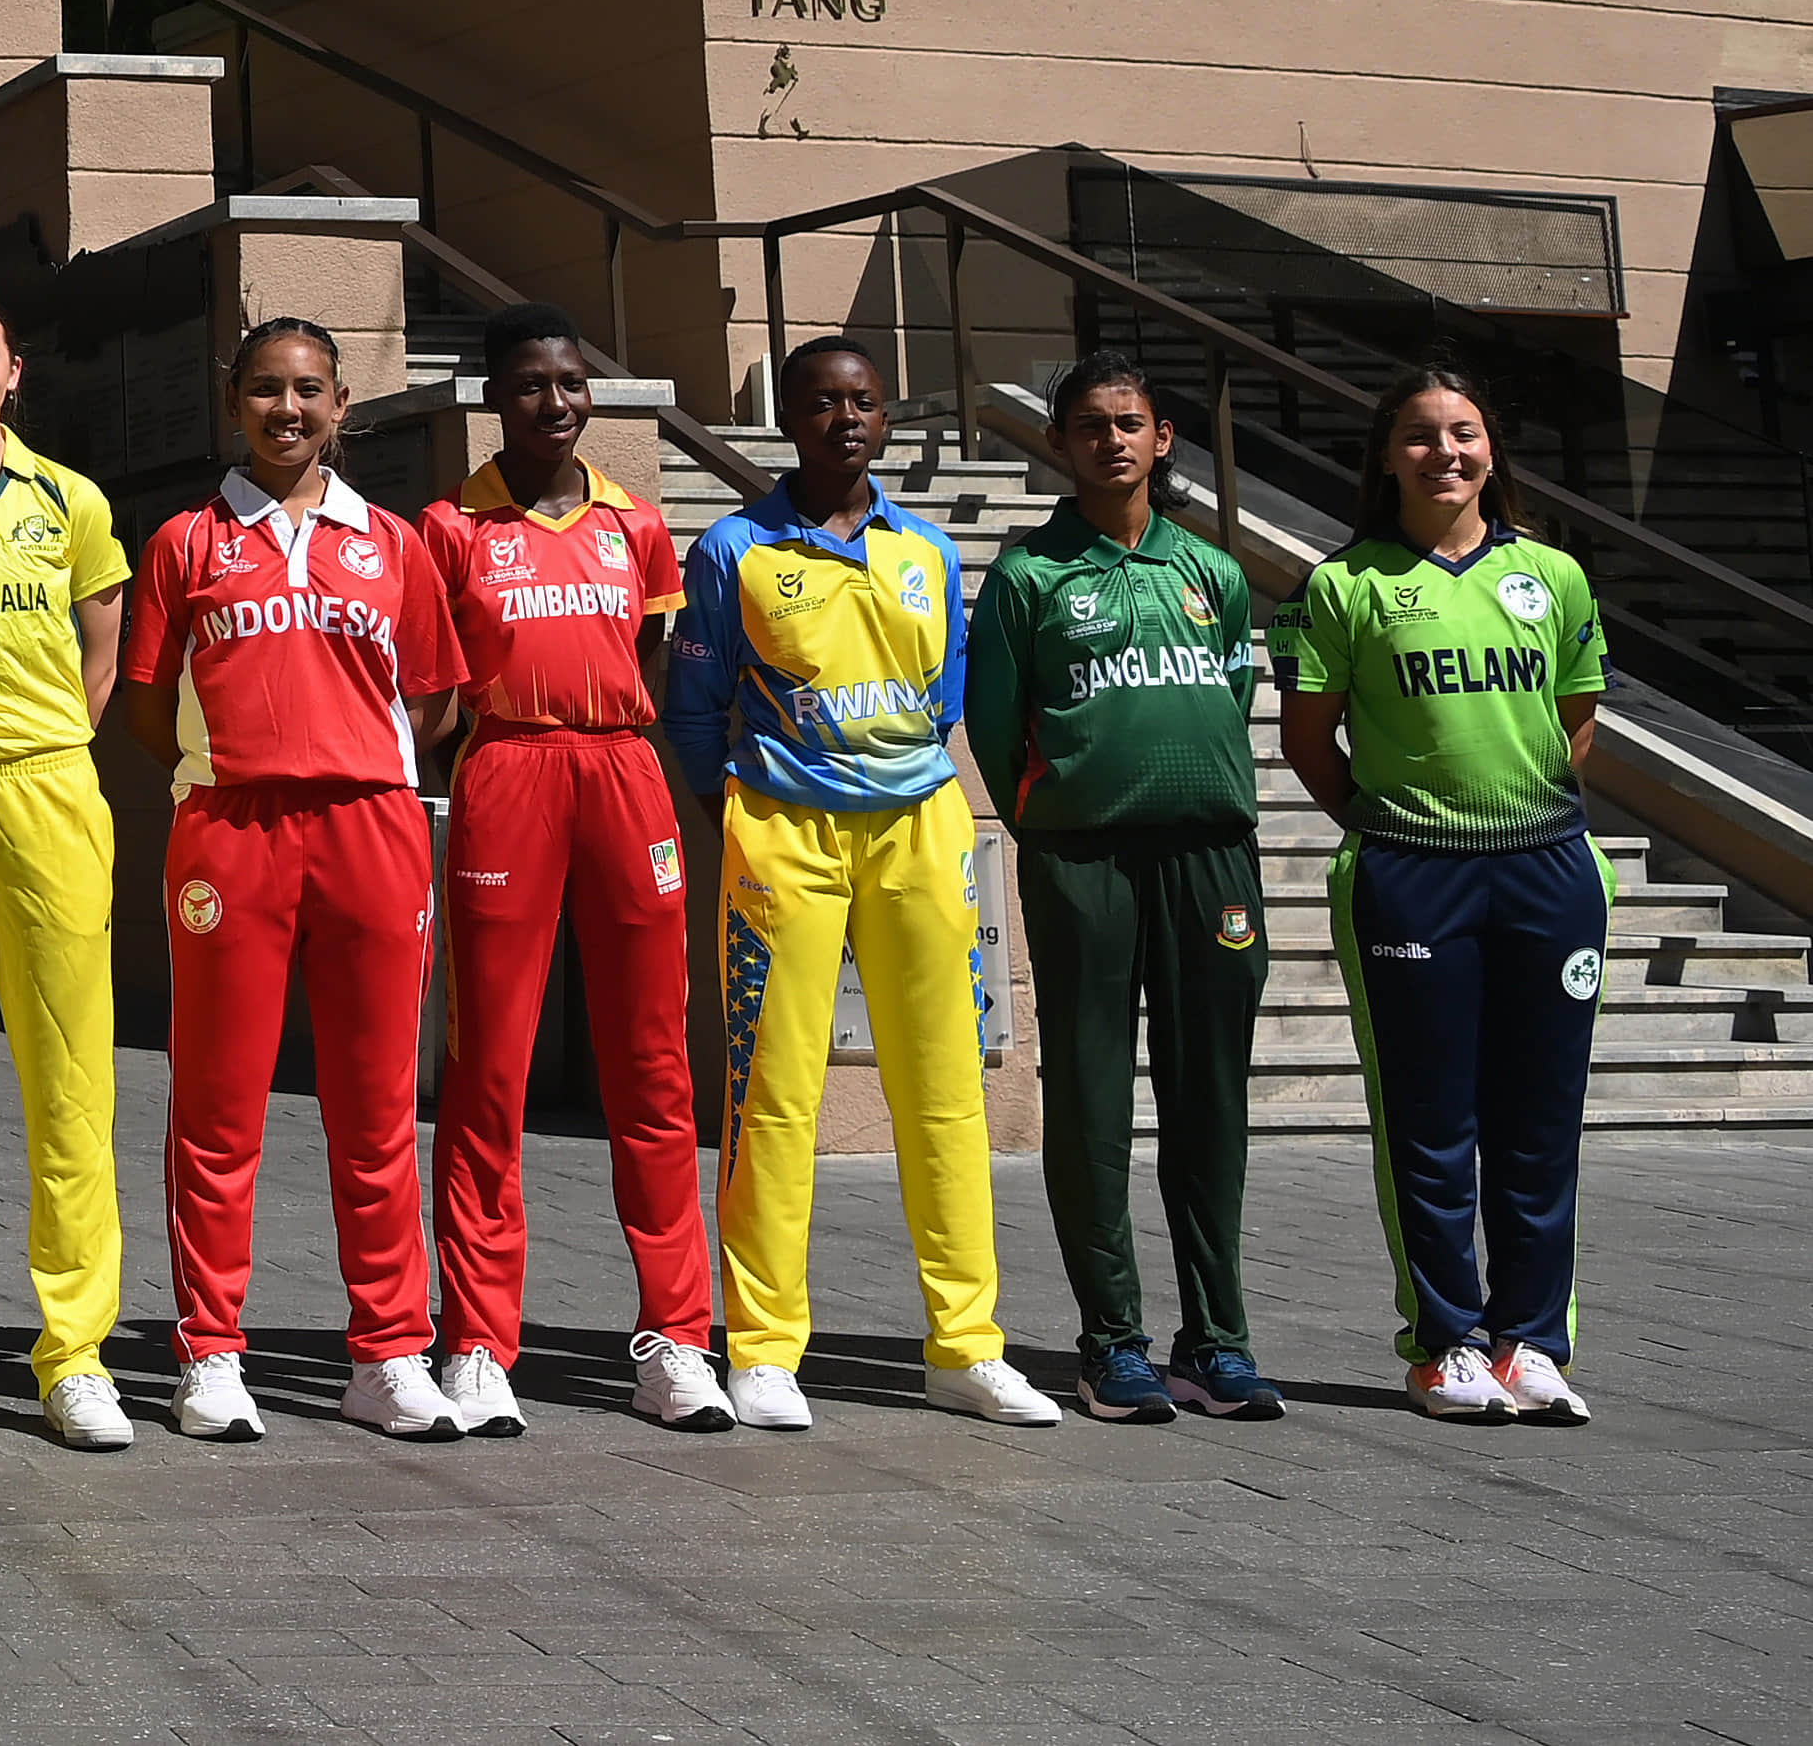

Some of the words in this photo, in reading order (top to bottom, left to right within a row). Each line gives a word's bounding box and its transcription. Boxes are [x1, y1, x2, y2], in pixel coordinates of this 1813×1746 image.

[201, 591, 393, 656] INDONESIA
[497, 582, 631, 623] ZIMBABWE
[1068, 645, 1231, 700] BANGLADES
[1392, 646, 1547, 698] IRELAND
[792, 677, 936, 726] RWAN
[842, 986, 863, 995] Arou
